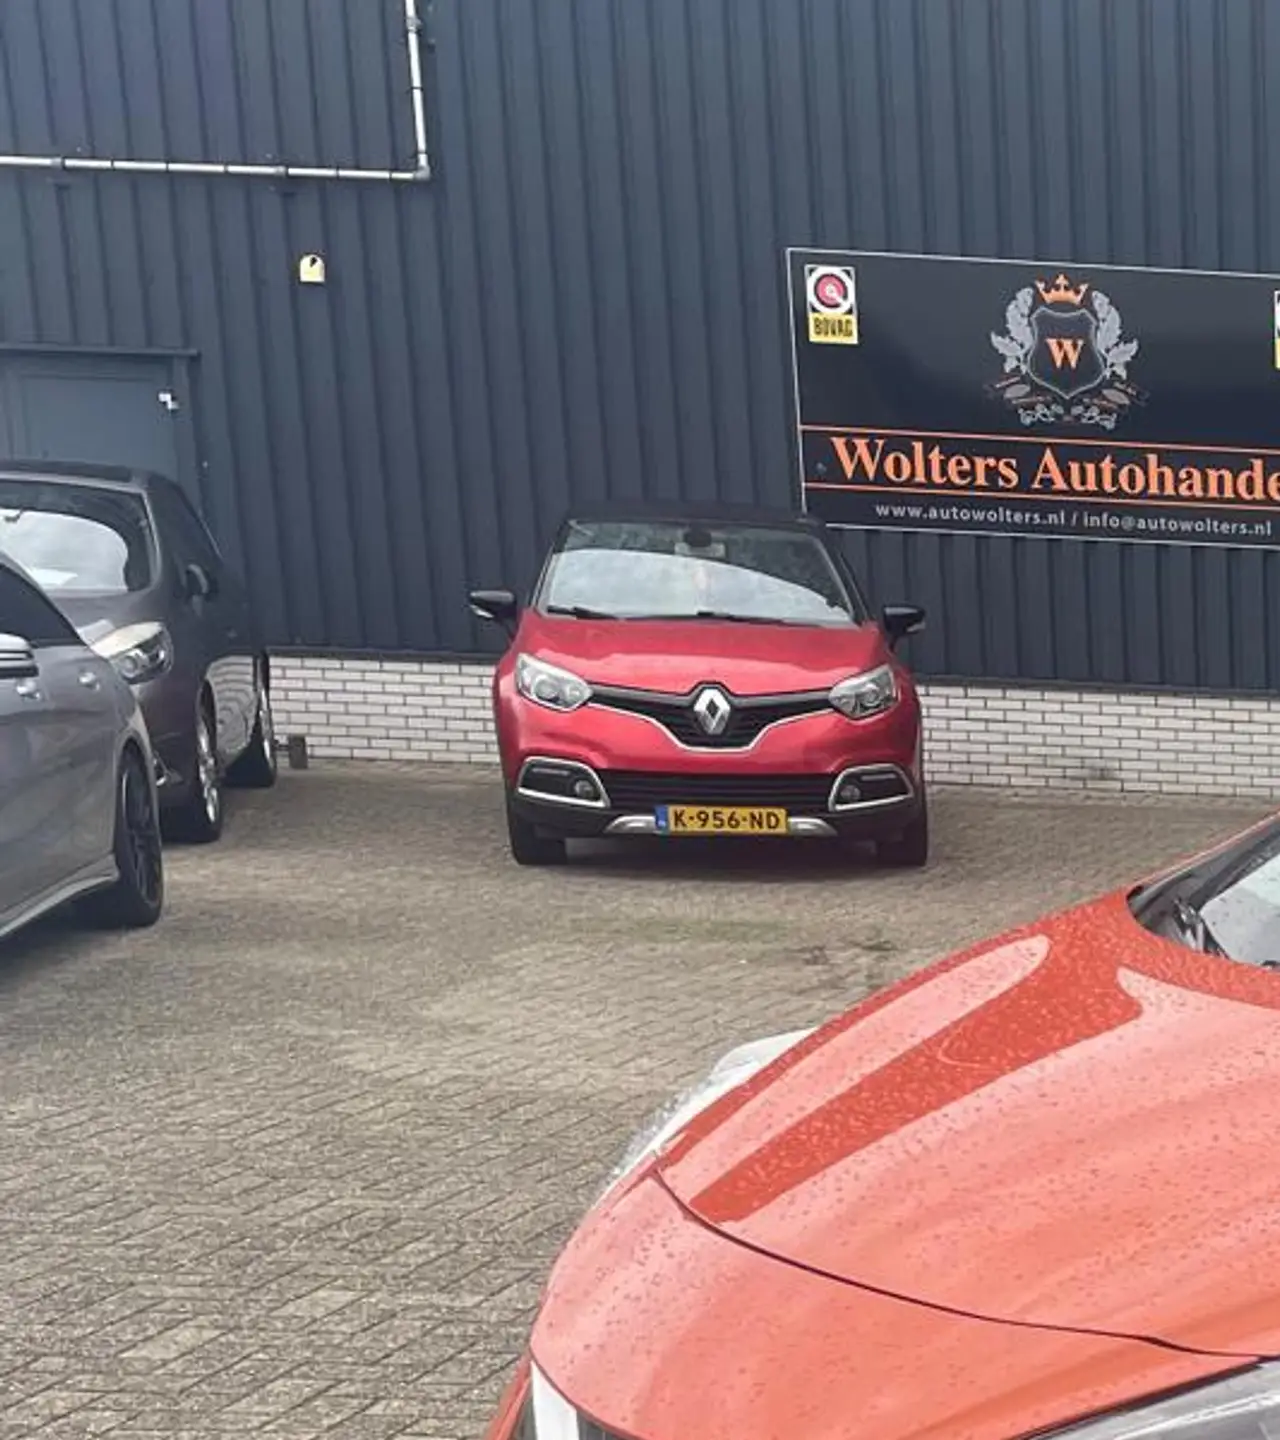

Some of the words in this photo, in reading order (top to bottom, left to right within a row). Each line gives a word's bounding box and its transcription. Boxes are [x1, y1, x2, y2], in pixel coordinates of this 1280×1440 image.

[813, 316, 853, 338] BOVAG
[1045, 337, 1084, 371] W
[831, 436, 1018, 490] Wolters
[875, 502, 1066, 526] www.autowolters.nl
[1083, 510, 1273, 537] info@autowolters.nl
[673, 808, 780, 829] K-956-ND
